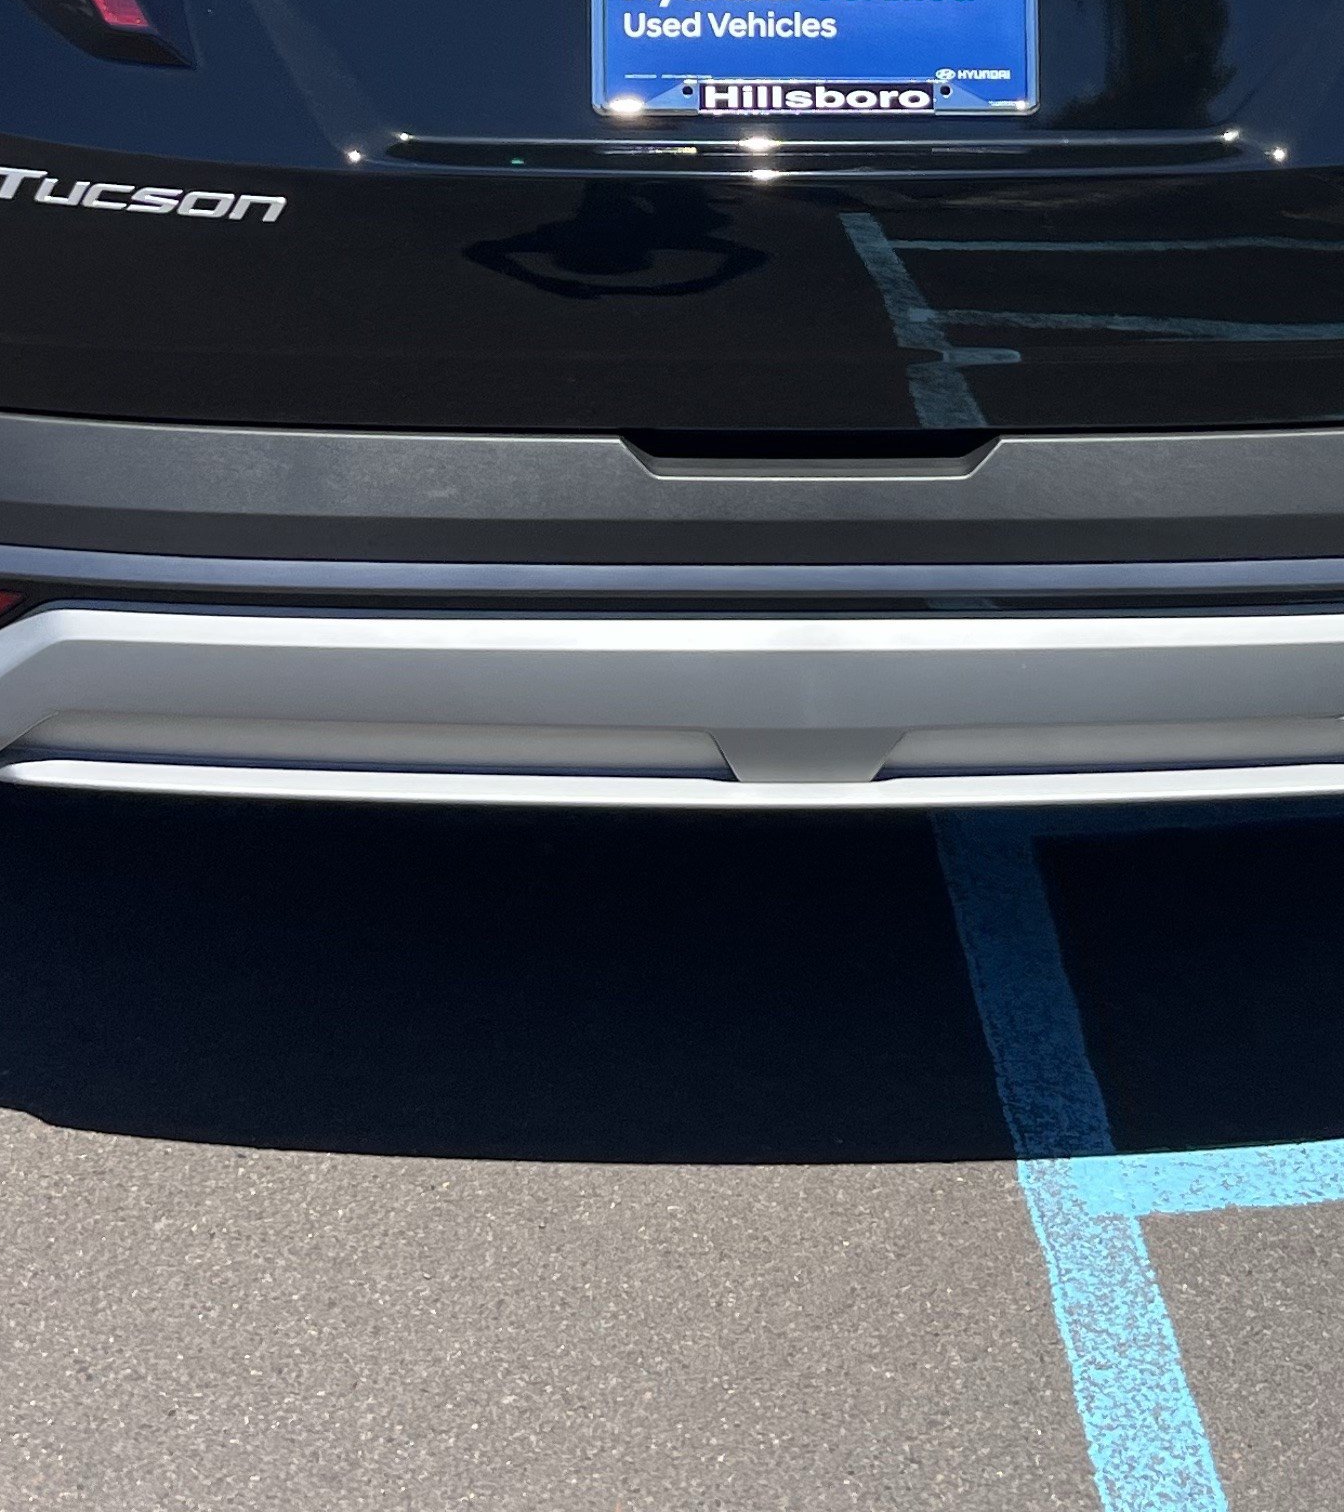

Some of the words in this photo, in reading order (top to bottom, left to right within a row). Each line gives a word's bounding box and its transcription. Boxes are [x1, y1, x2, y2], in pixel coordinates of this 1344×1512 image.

[623, 11, 701, 38] Used
[707, 11, 837, 38] Vehicles
[705, 85, 931, 109] Hillsboro
